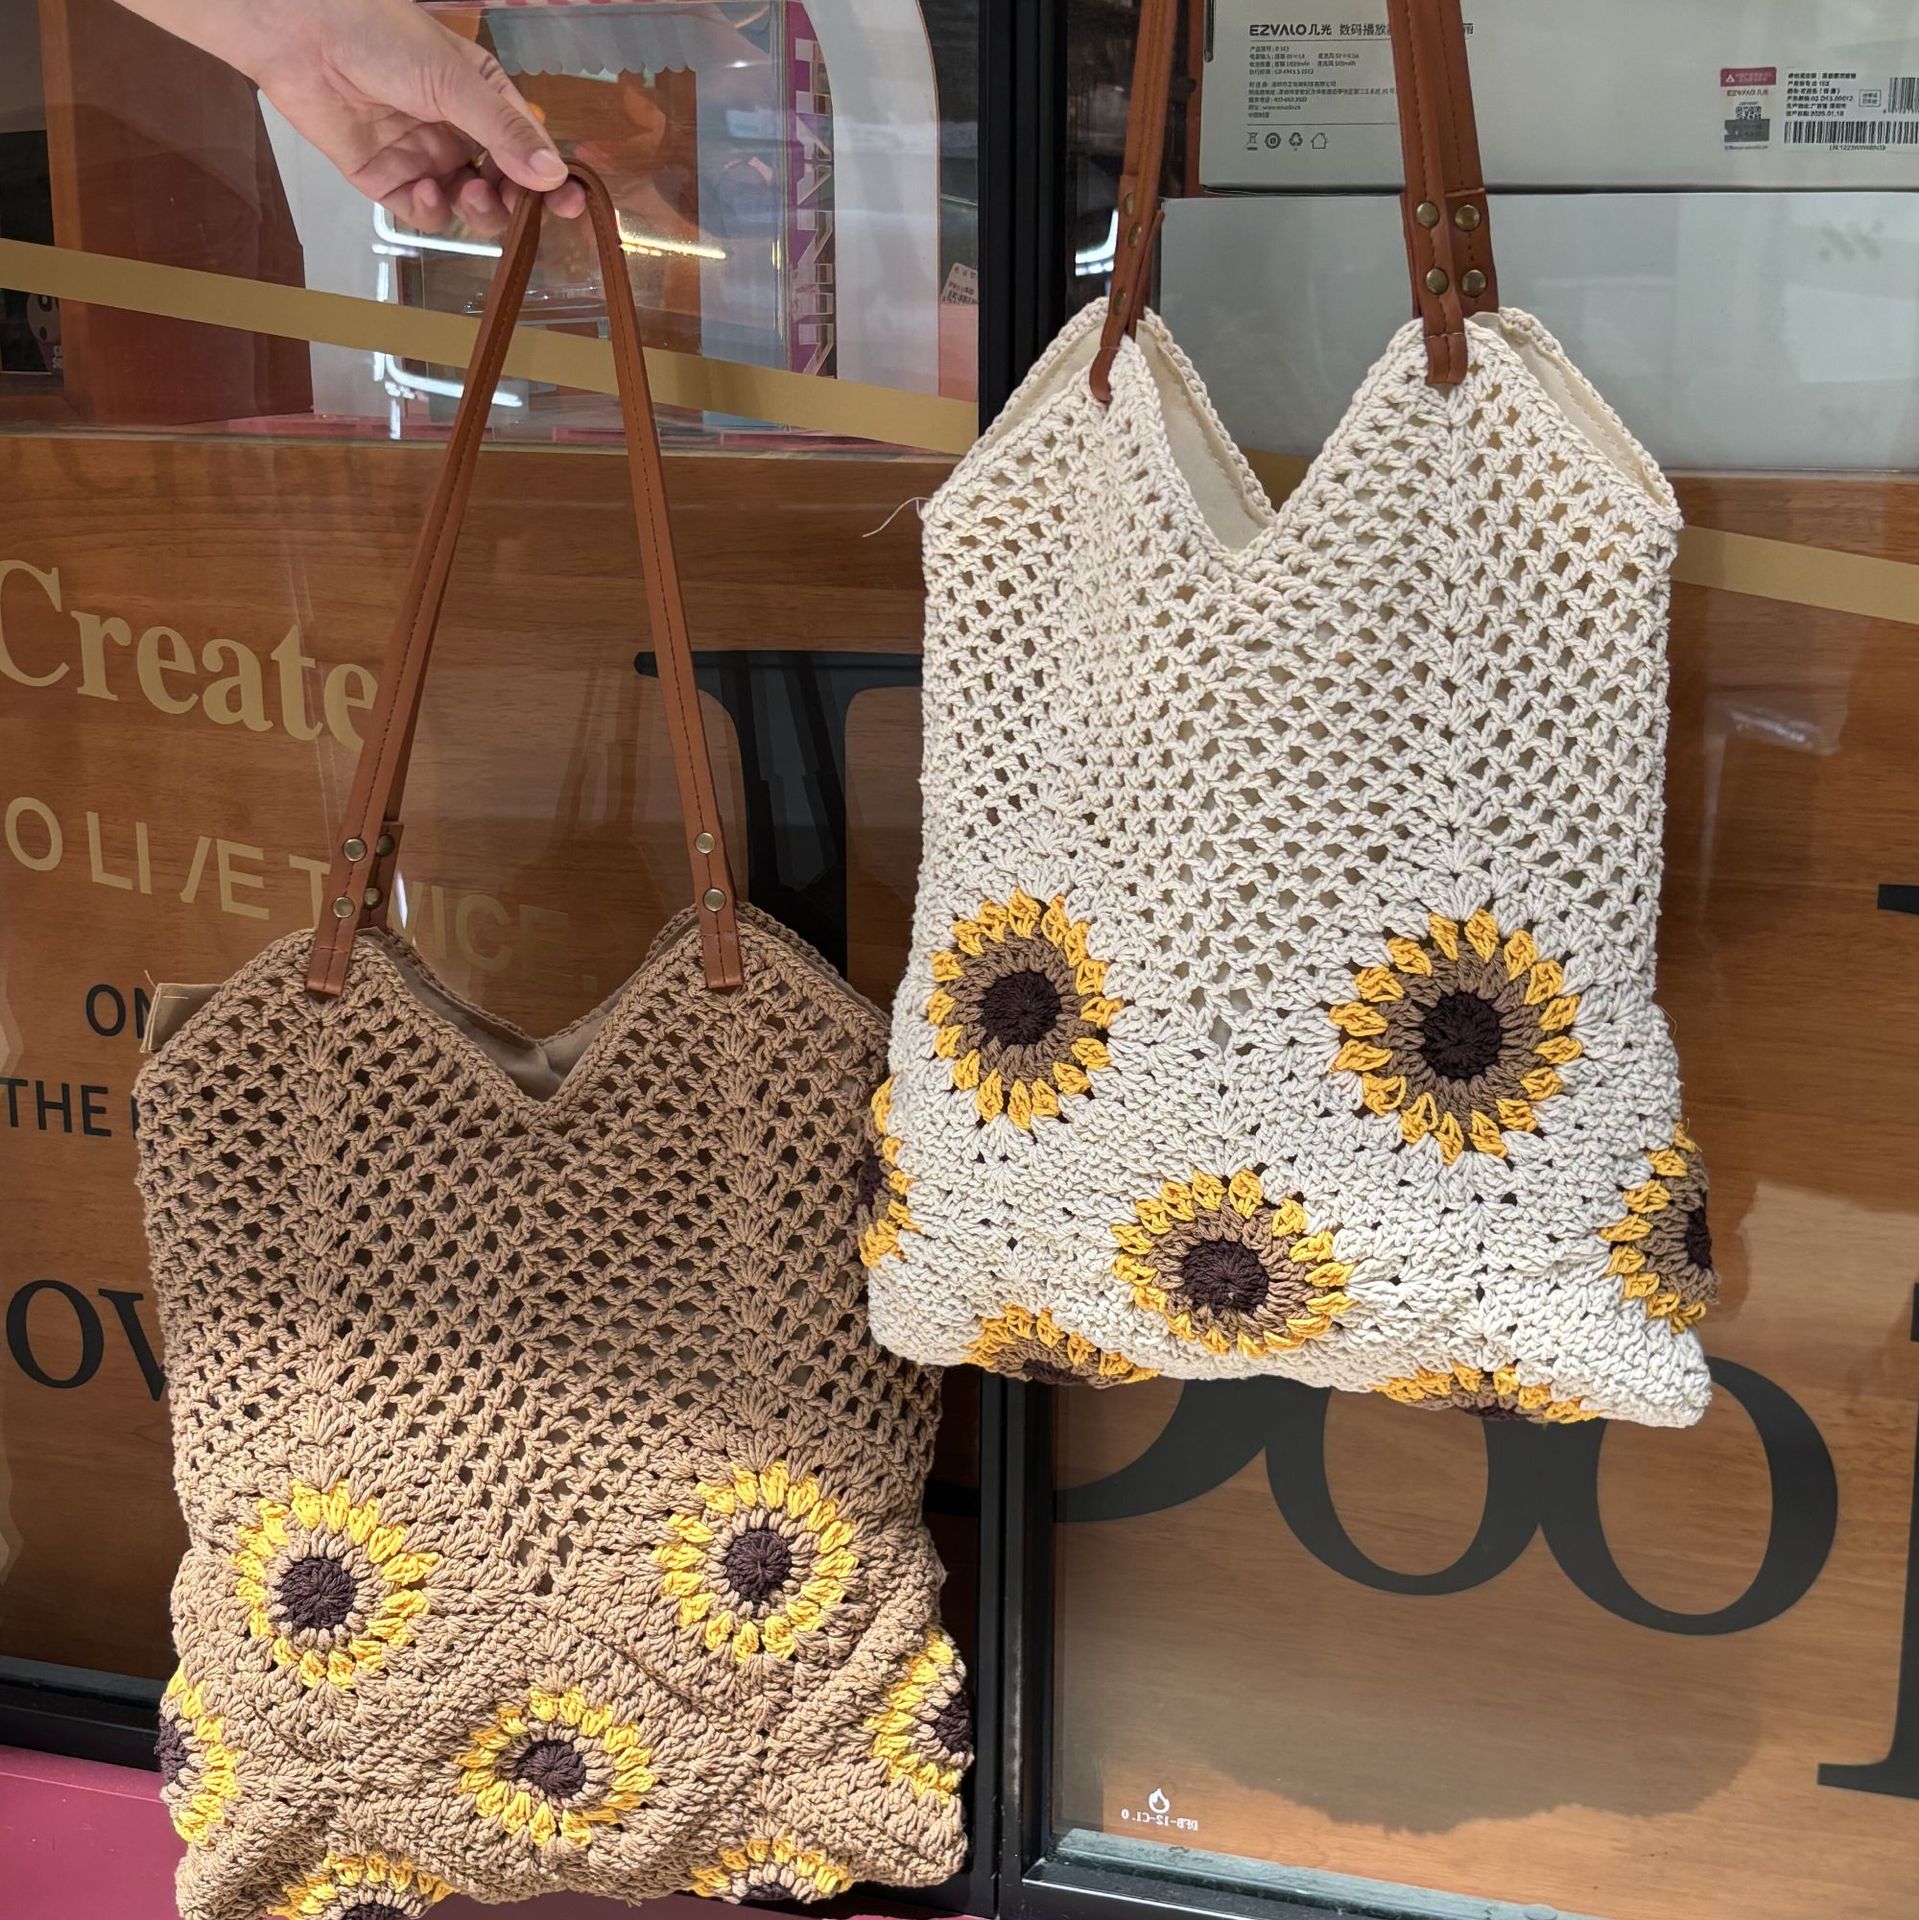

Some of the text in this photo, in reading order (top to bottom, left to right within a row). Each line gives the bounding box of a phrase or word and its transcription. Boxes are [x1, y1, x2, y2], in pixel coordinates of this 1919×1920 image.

[1339, 23, 1391, 36] 数码播放
[0, 559, 379, 753] Create
[1, 1078, 112, 1137] THE
